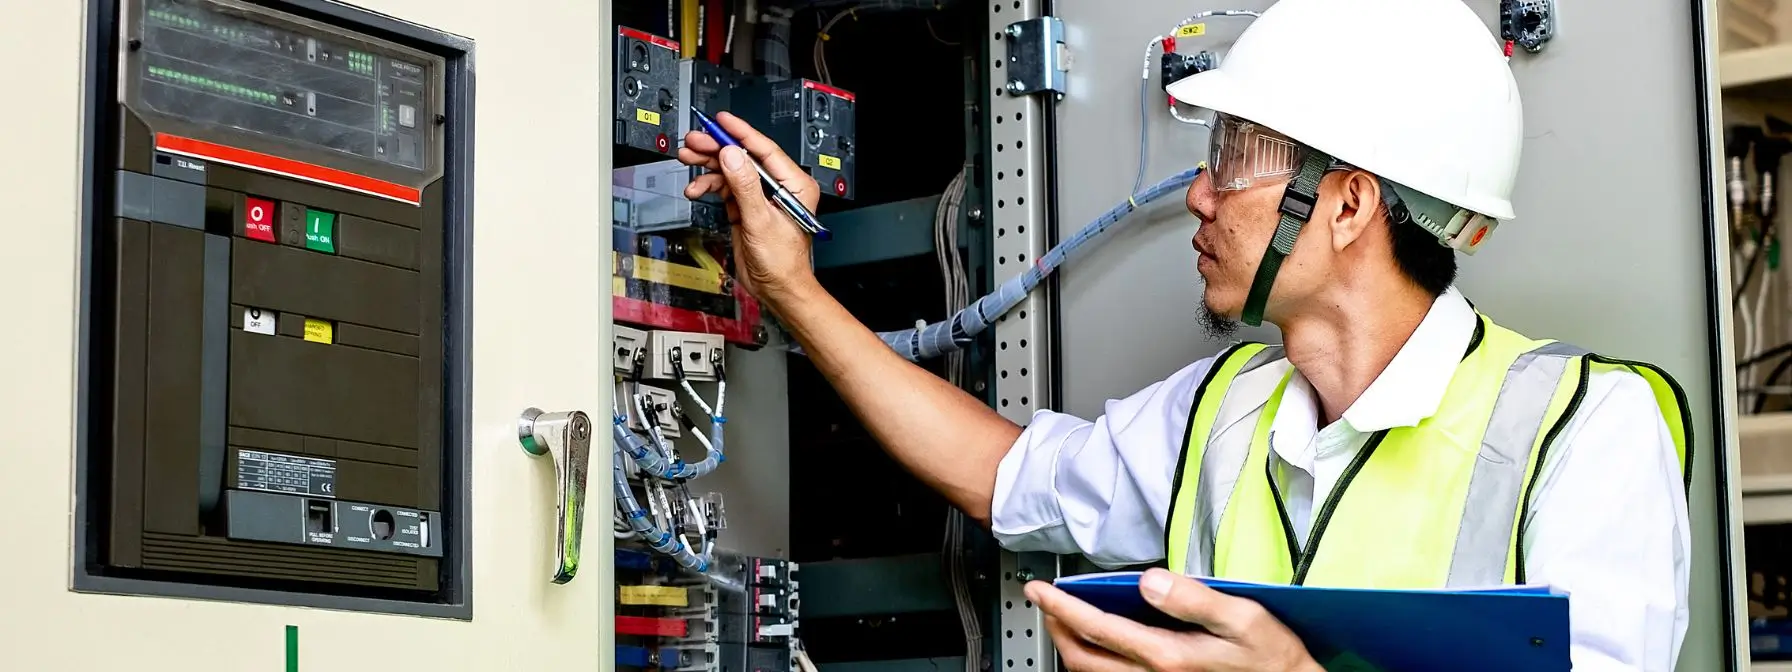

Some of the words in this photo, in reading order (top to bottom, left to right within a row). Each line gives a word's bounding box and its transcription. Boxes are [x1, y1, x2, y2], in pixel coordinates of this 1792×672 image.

[1183, 26, 1199, 35] SW2
[258, 224, 271, 232] OFF
[320, 235, 330, 244] ON
